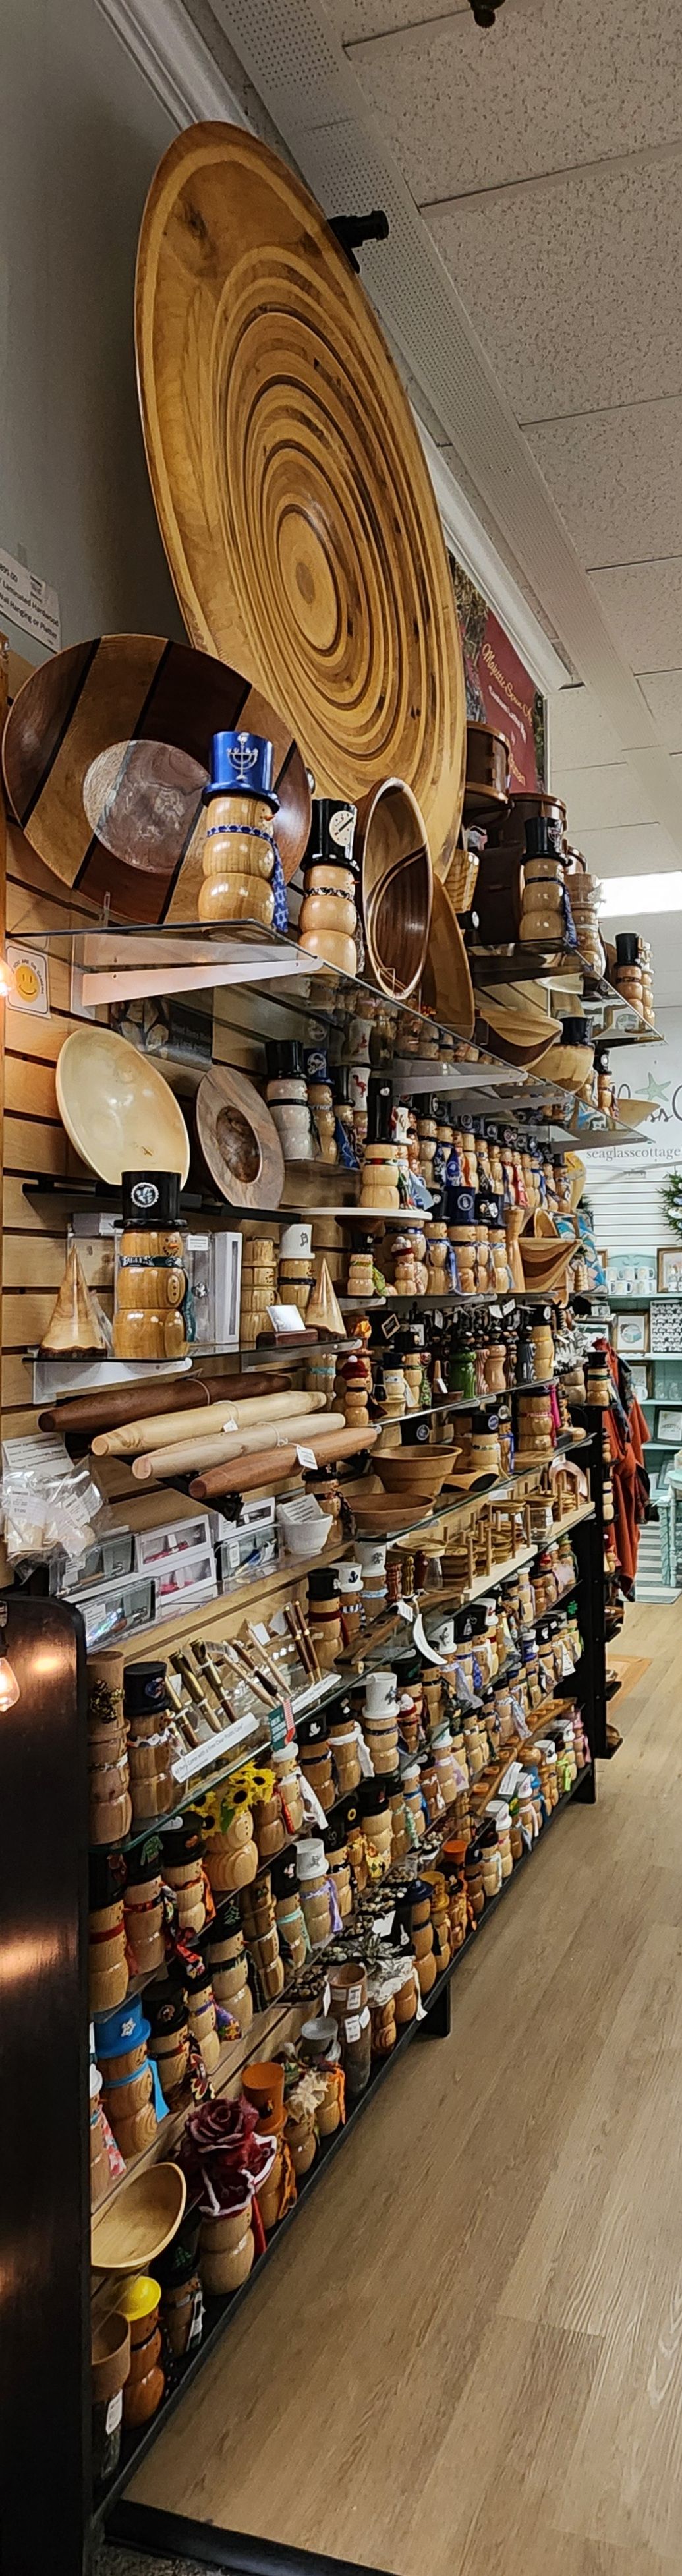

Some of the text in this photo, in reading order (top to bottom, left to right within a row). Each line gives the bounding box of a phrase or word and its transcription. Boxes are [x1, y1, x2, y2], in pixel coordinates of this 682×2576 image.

[3, 579, 31, 606] Laminated
[32, 602, 59, 627] Hardwood
[10, 600, 32, 624] Hanging
[482, 643, 505, 688] Majestic
